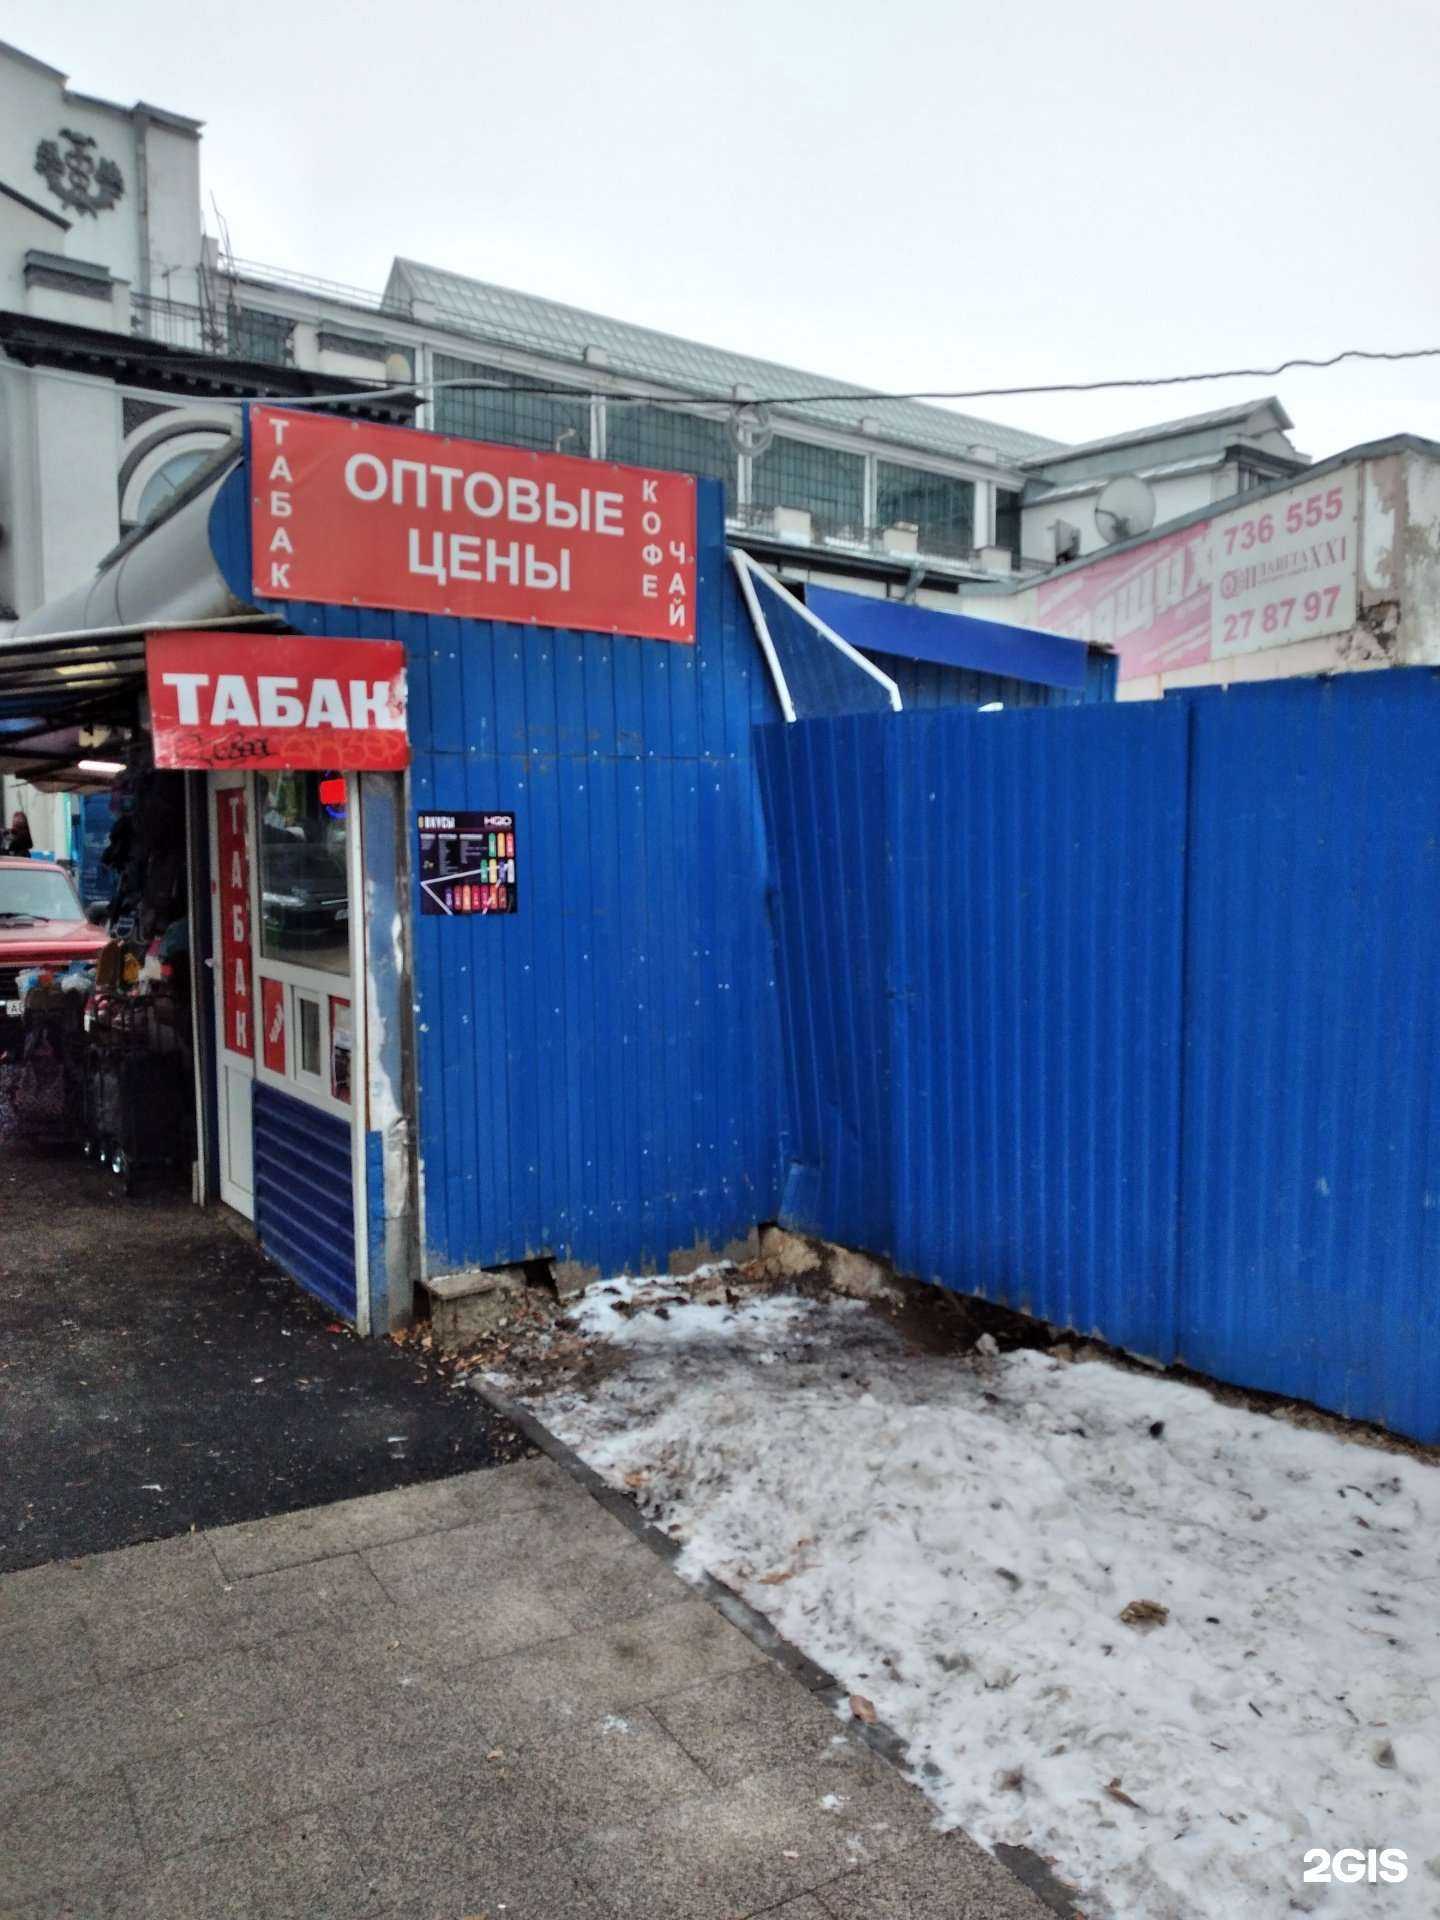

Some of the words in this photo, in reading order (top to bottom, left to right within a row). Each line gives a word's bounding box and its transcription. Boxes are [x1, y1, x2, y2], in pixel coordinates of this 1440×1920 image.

[268, 418, 293, 590] ТАБАК
[344, 452, 625, 537] ОПТОВЫЕ
[1223, 512, 1274, 556] 736
[1285, 486, 1344, 535] 555
[408, 527, 571, 592] ЦЕНЫ
[641, 479, 664, 599] КОФЕ
[668, 541, 687, 628] ЧАЙ
[1223, 608, 1256, 643] 27
[1262, 596, 1297, 633] 87
[1303, 584, 1342, 623] 97
[162, 672, 407, 732] ТАБАК
[229, 797, 248, 1049] ТАБАК
